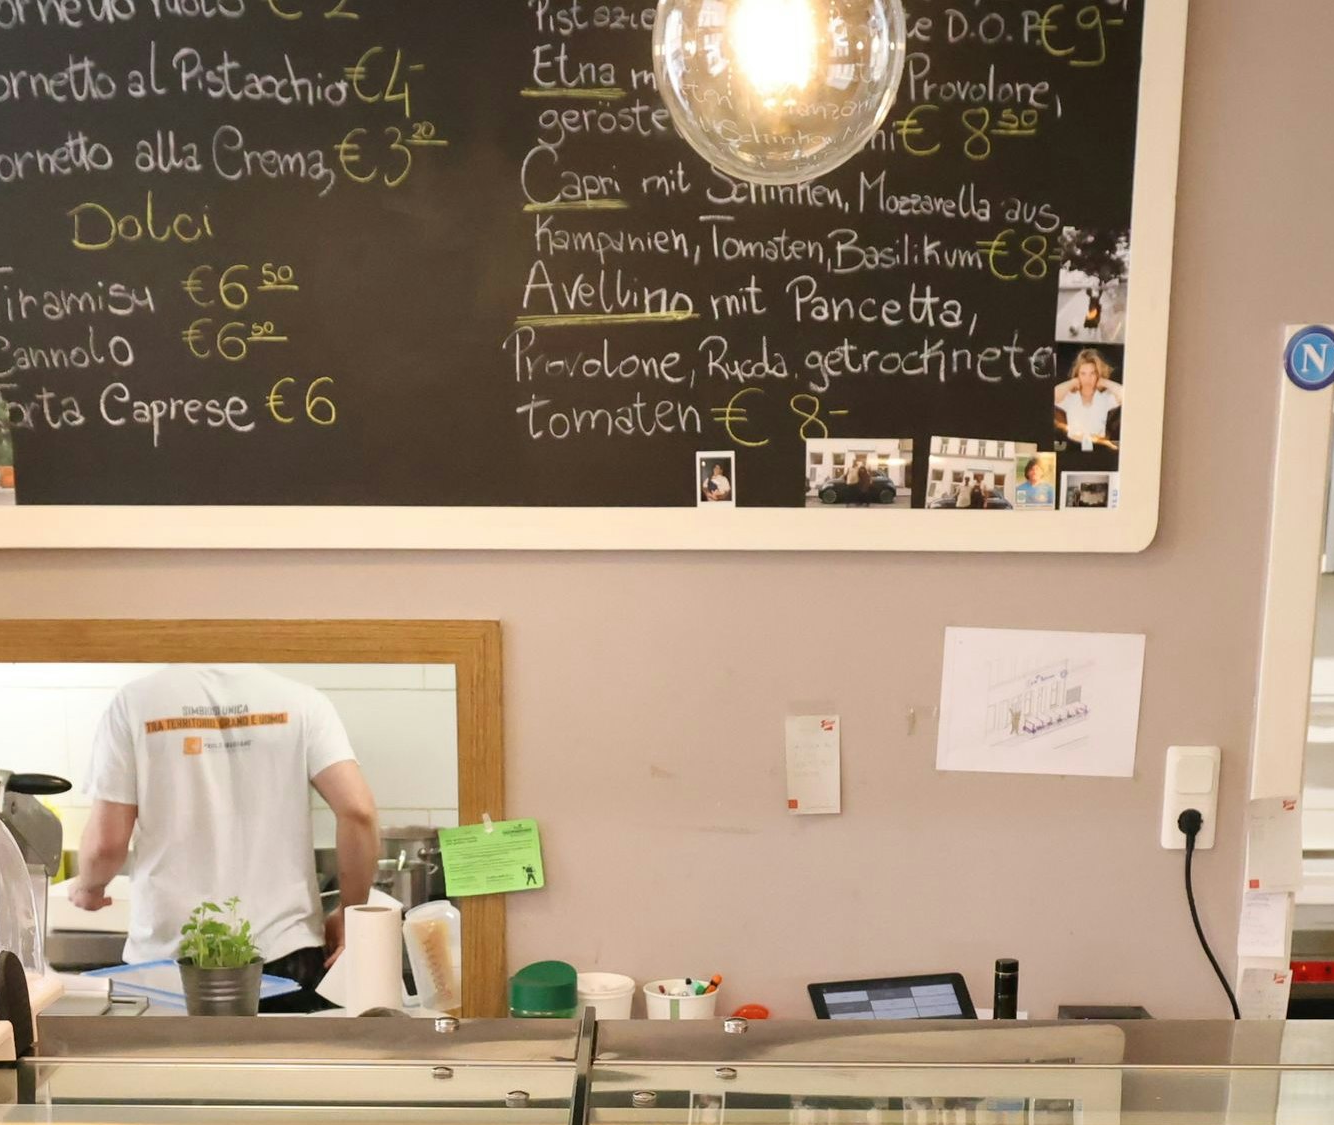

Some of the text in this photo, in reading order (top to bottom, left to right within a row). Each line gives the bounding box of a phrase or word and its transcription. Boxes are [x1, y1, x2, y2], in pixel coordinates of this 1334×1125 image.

[127, 39, 167, 98] al
[171, 46, 349, 107] Pistacchio
[532, 42, 616, 88] Etna
[903, 52, 1062, 118] Provolone,
[135, 128, 202, 175] alla
[521, 143, 621, 208] Capri
[642, 161, 691, 197] mit
[859, 169, 991, 222] Mozzarella
[67, 190, 215, 250] Dolci
[534, 213, 702, 266] Kampanien,
[522, 259, 977, 337] Avellino mit Pancetta,
[502, 325, 696, 389] Provolone,
[1301, 342, 1330, 374] N
[100, 382, 256, 448] Caprese
